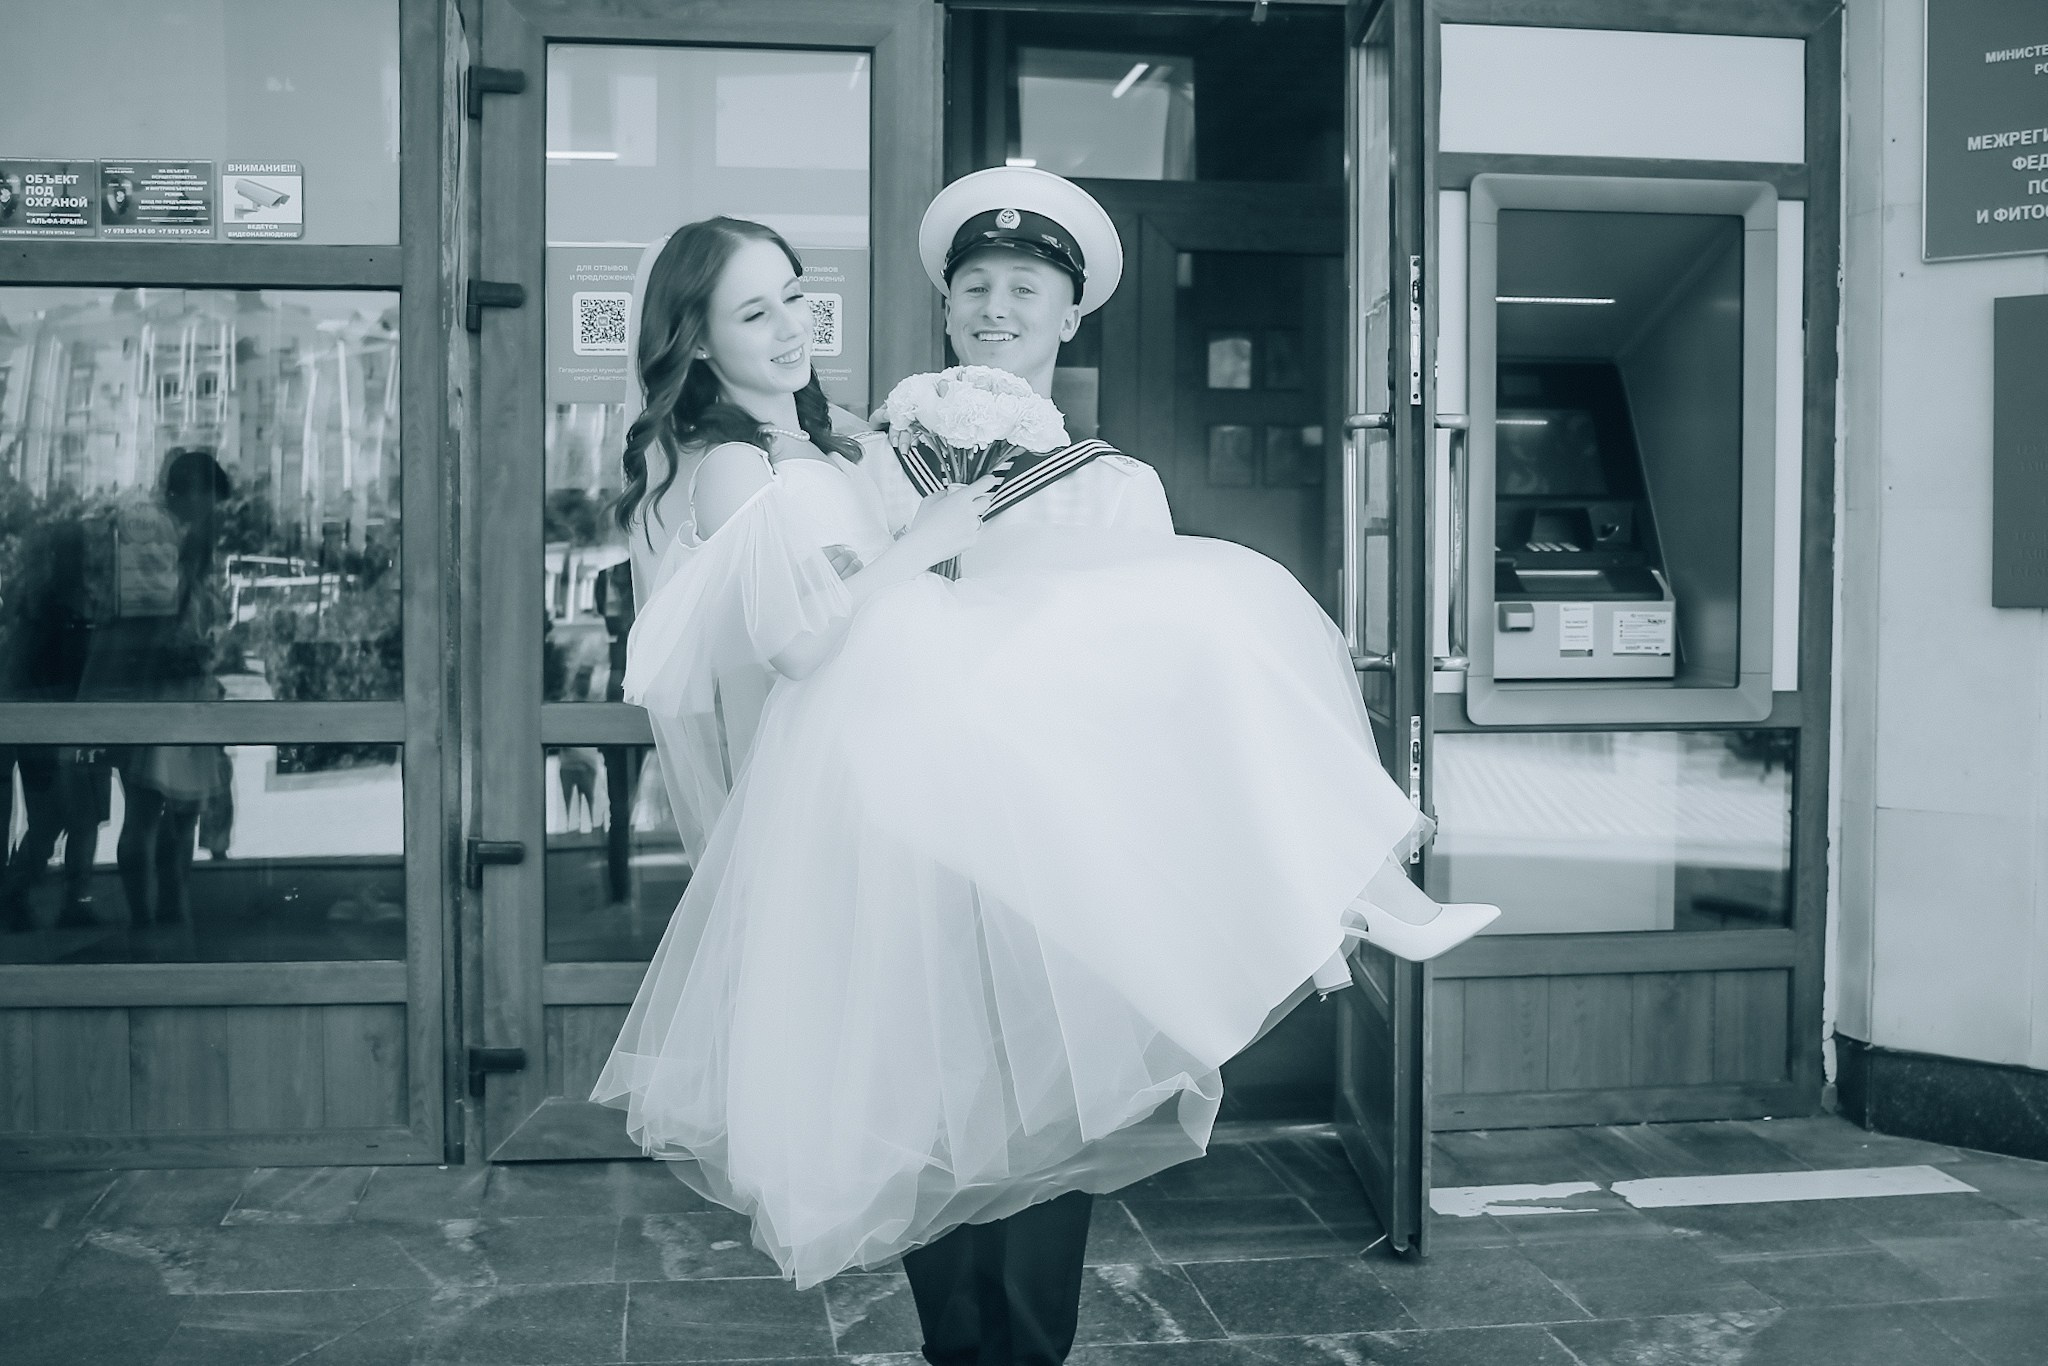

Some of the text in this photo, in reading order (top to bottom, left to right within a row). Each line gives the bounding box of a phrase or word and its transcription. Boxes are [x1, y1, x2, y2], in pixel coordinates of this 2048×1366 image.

[1985, 44, 2048, 64] МИНИСТЕ
[227, 164, 297, 173] ВНИМАНИЕ!!!
[25, 174, 79, 184] ОБЪЕКТ
[25, 186, 54, 197] ПОД
[25, 196, 88, 207] ОХРАНОЙ
[1976, 204, 2048, 224] И ФИТО
